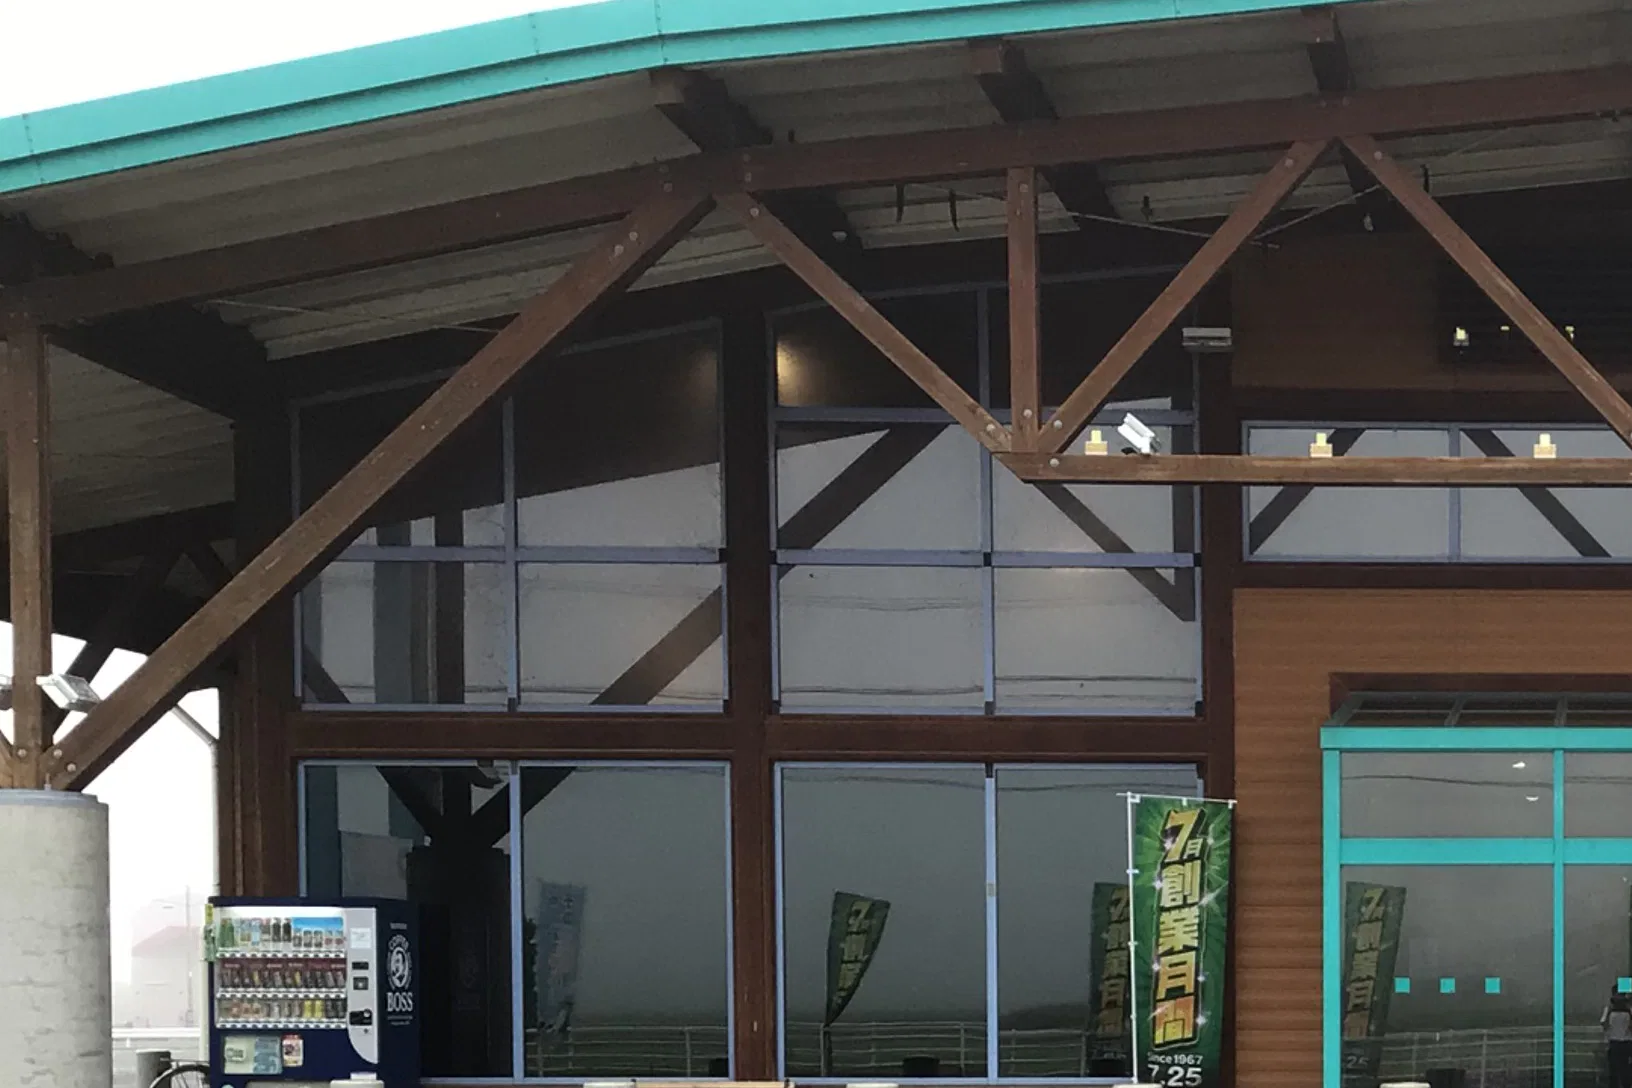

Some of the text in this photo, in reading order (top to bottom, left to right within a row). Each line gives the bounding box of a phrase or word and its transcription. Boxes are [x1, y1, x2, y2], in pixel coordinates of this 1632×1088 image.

[1154, 809, 1203, 1046] 7月創業月間
[387, 992, 413, 1012] BOSS
[1147, 1064, 1202, 1087] 7.25
